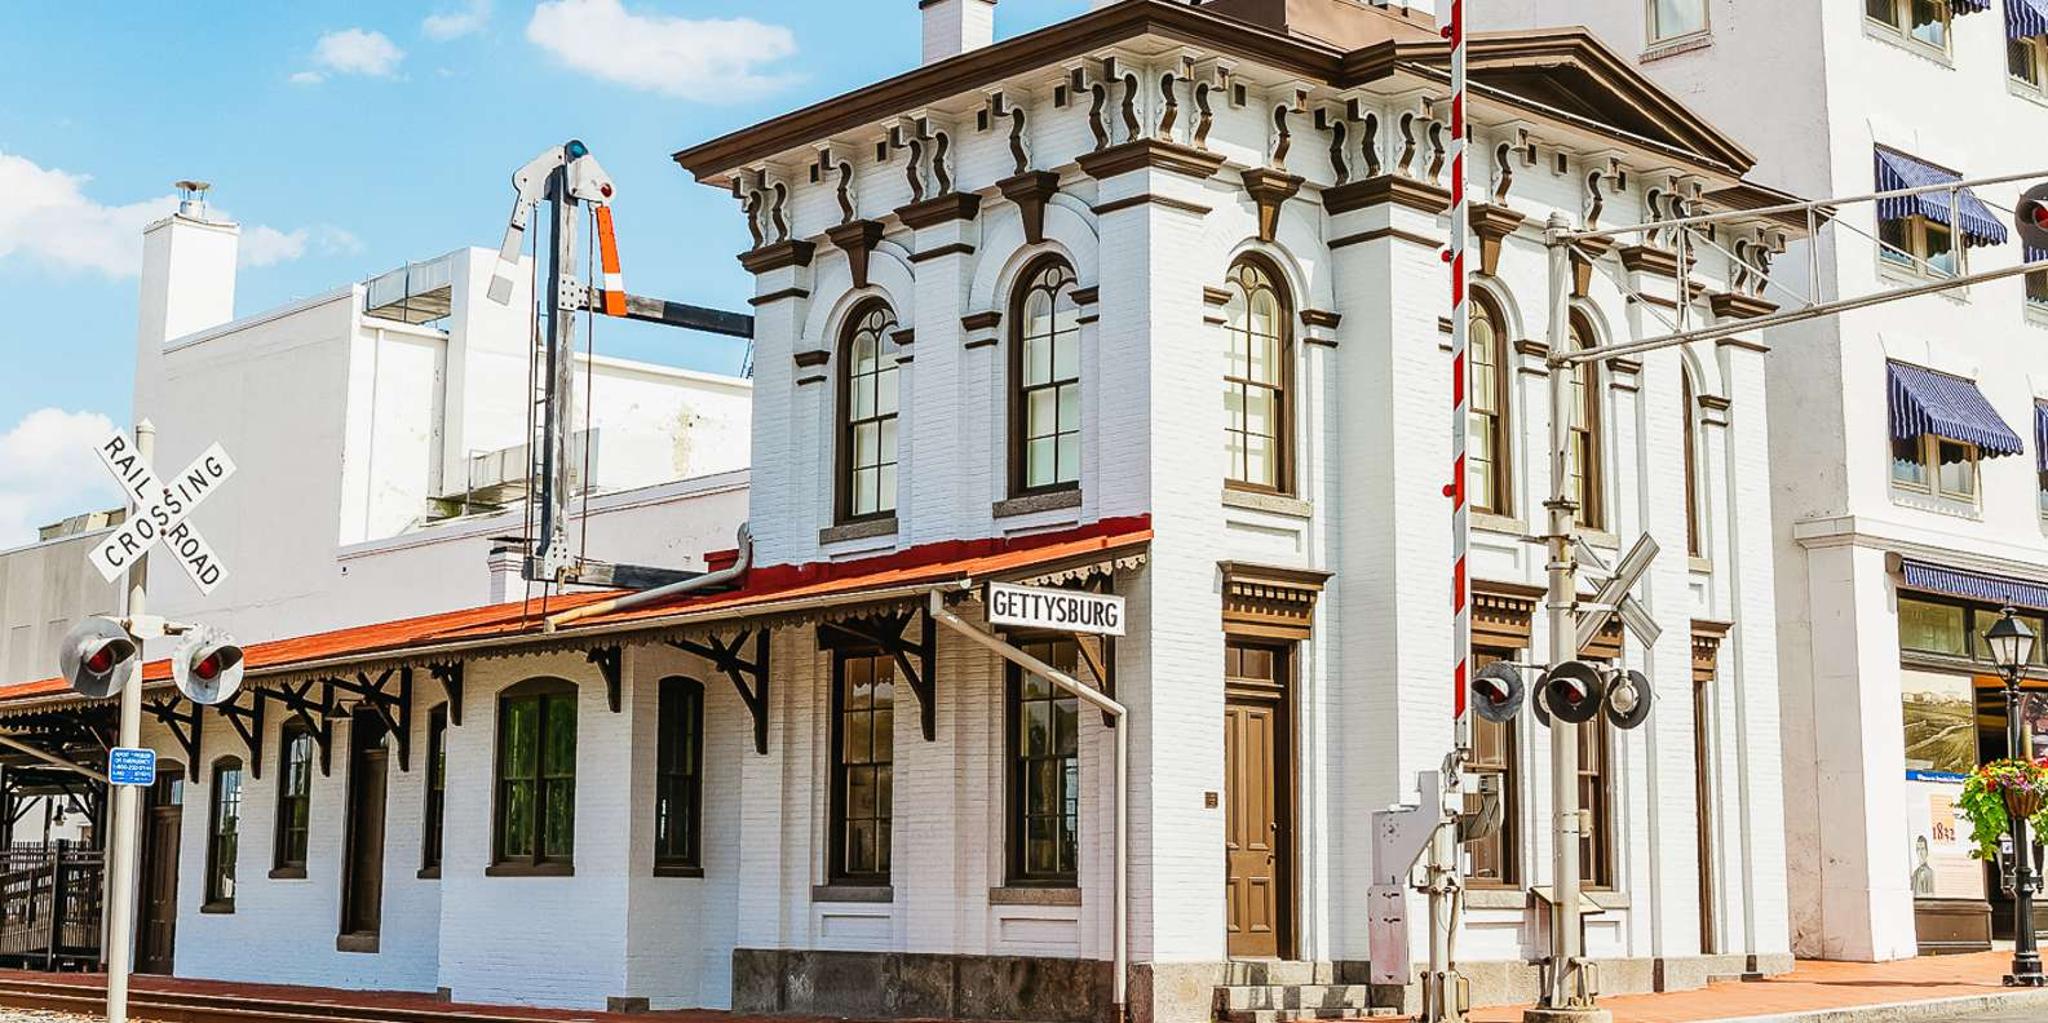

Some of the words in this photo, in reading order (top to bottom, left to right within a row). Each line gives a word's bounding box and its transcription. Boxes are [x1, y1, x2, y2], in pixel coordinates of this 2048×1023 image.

[104, 435, 151, 500] RAIL
[169, 522, 220, 586] ROAD
[104, 456, 223, 567] CROSSING
[993, 590, 1118, 627] GETTYSBURG
